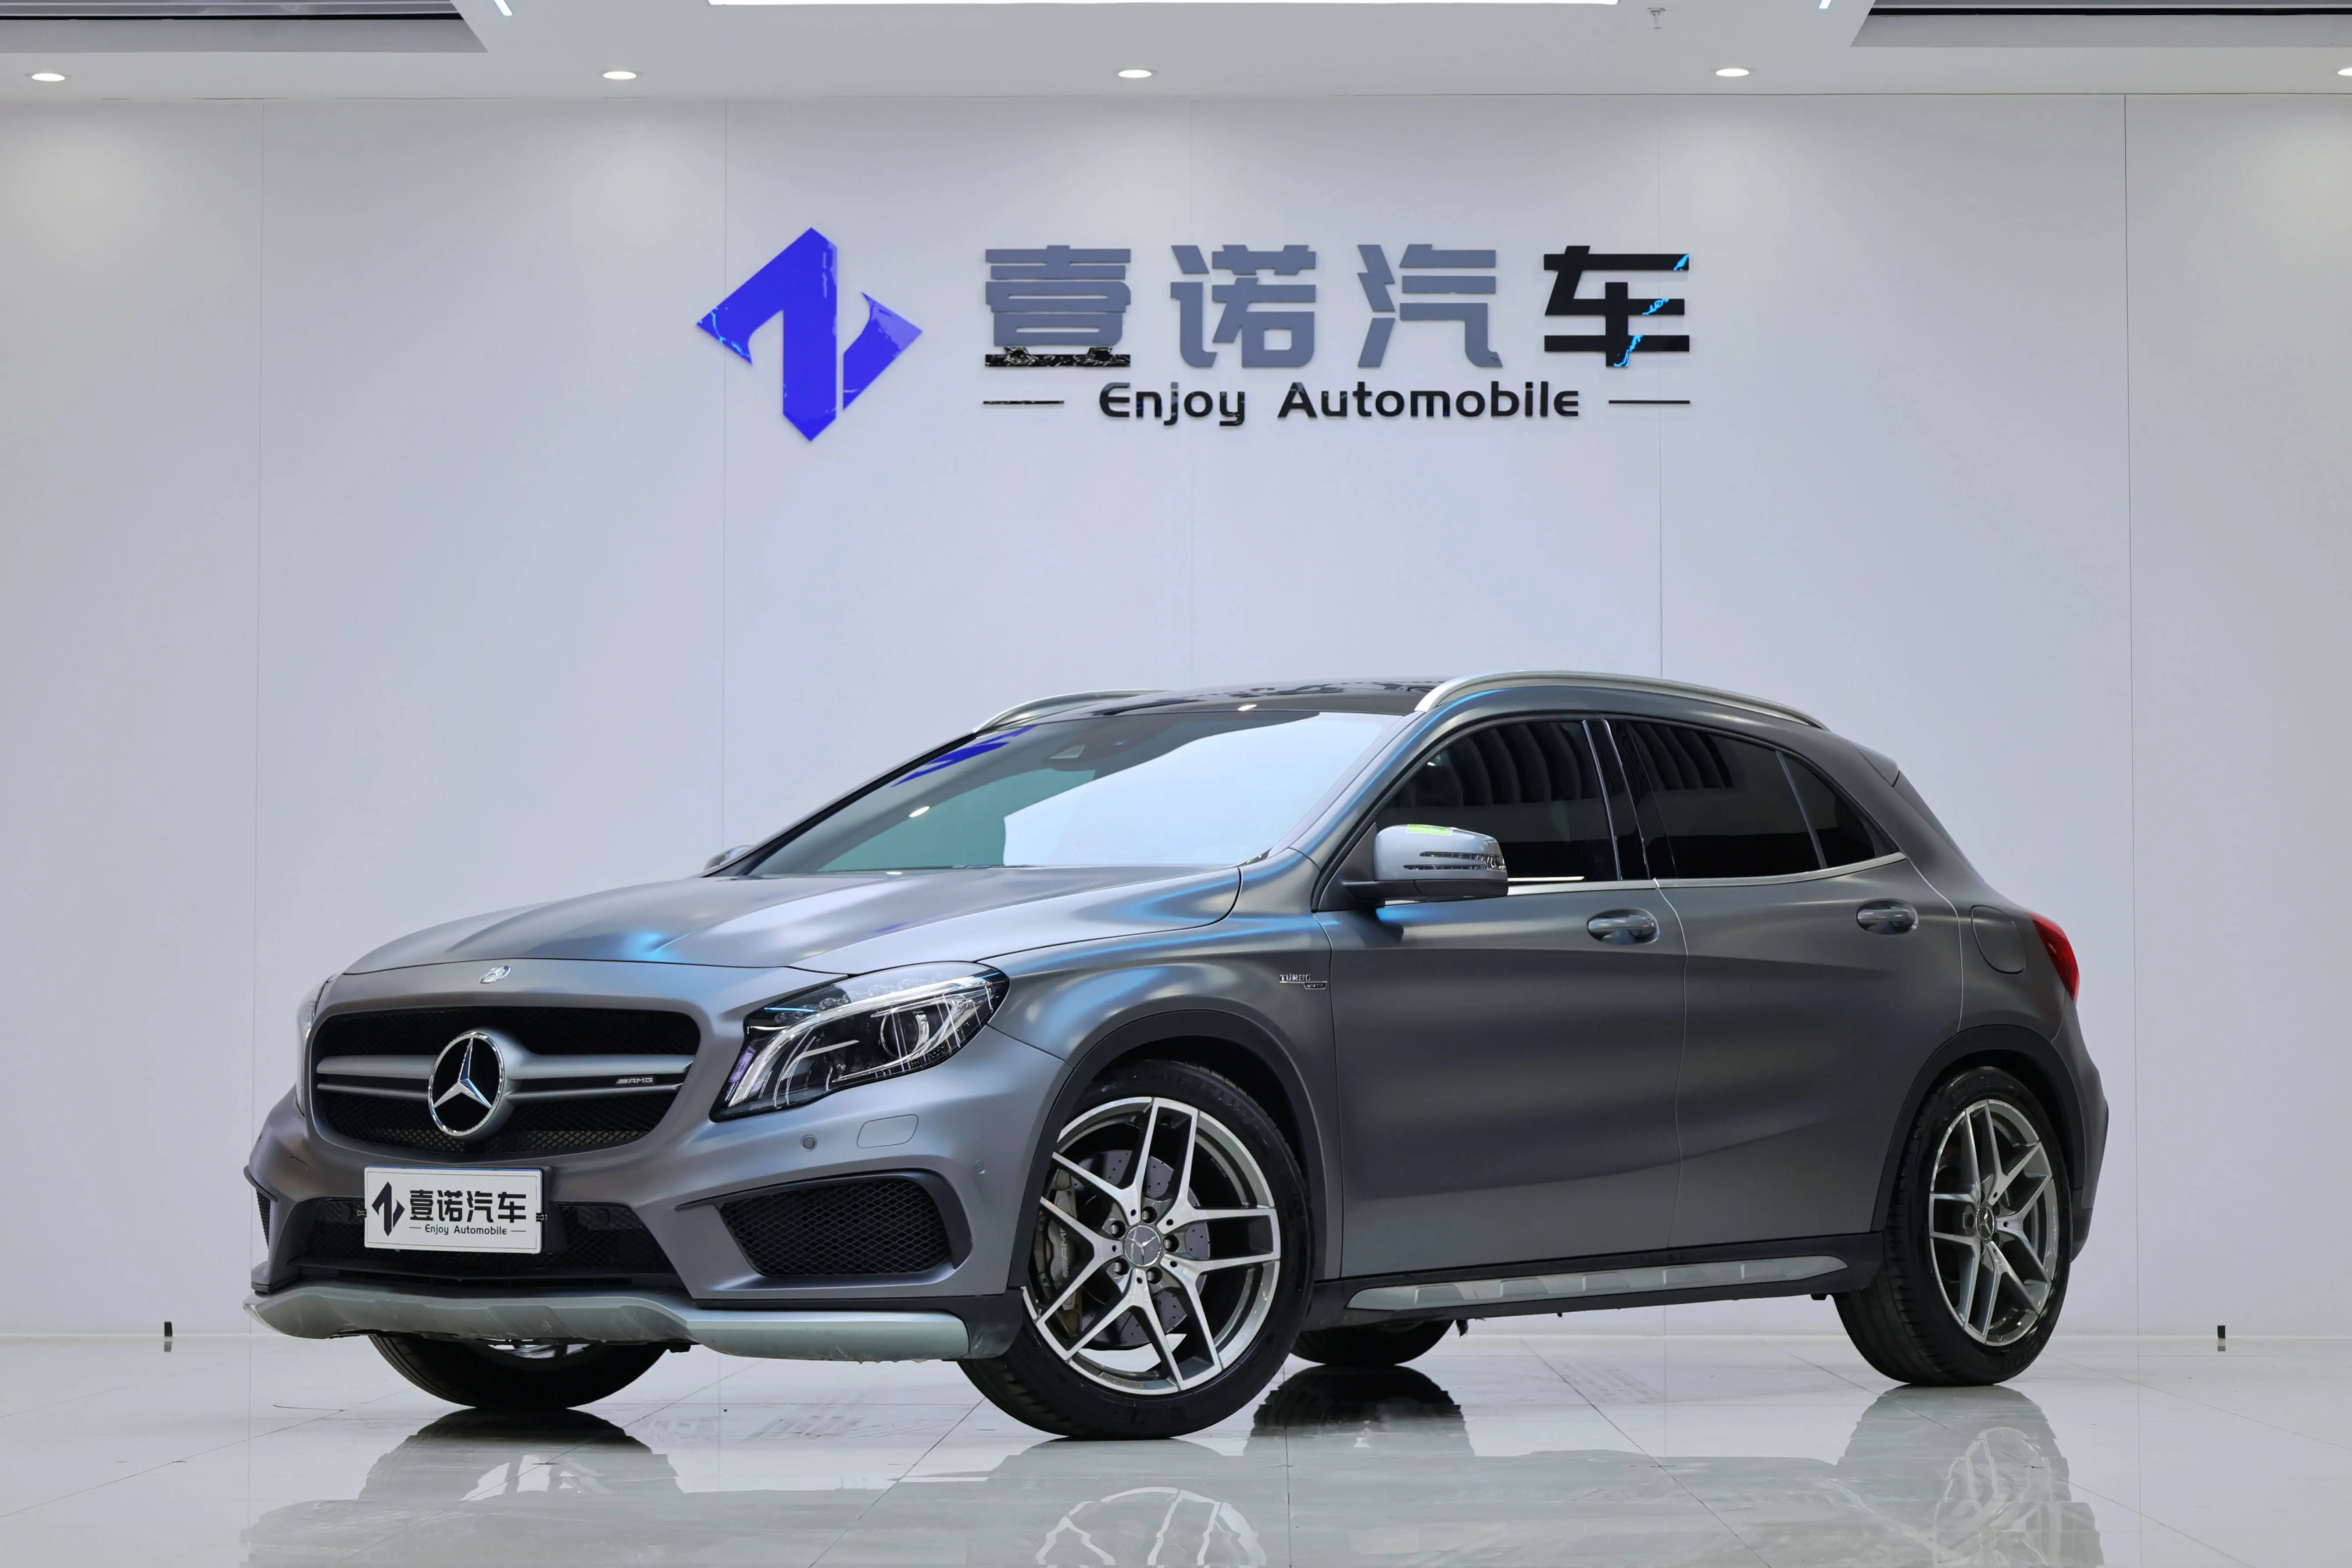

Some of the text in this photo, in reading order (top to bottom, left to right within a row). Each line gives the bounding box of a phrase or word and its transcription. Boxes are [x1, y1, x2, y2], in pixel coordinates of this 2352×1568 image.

[985, 244, 1691, 368] 壹诺汽车
[1099, 381, 1580, 427] Enjoy Automobile
[410, 1189, 526, 1223] 壹诺汽车
[425, 1224, 507, 1236] Enjoy Automobile
